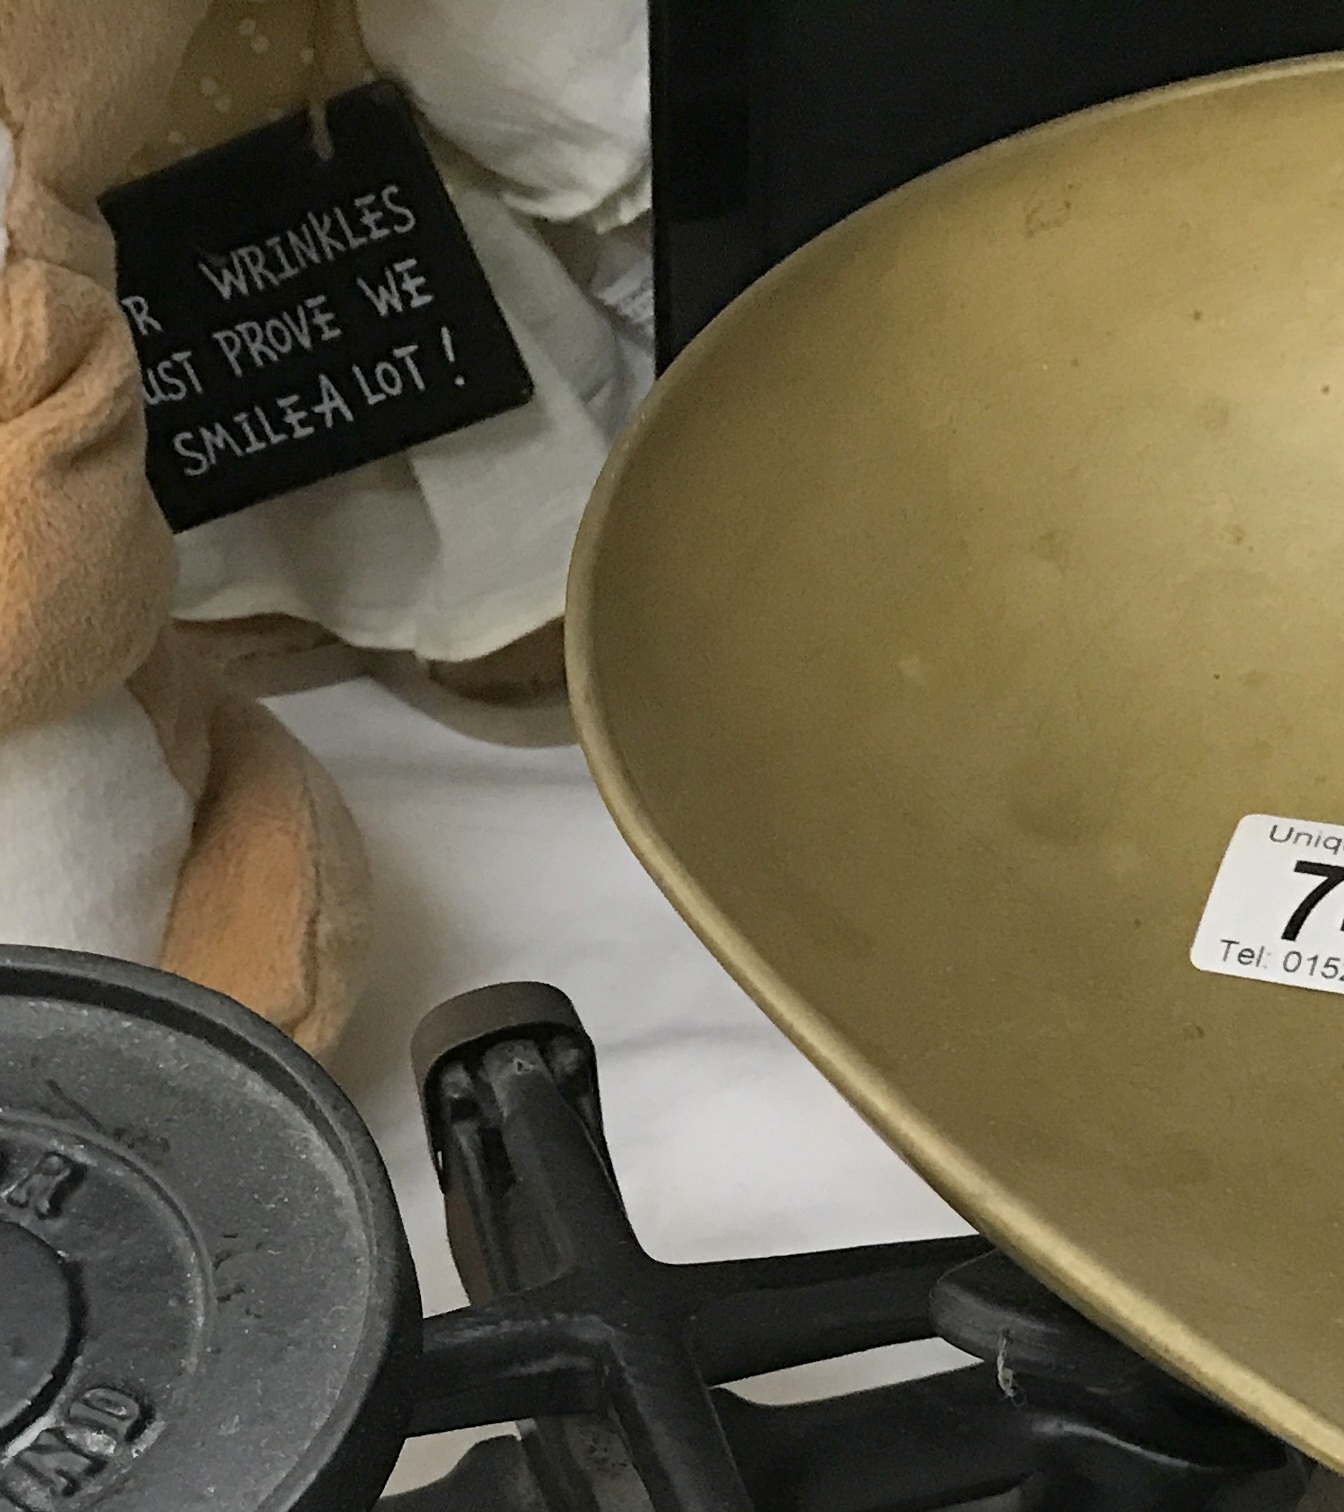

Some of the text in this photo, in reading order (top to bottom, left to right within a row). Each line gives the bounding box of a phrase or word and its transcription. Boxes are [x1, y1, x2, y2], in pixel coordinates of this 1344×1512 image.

[199, 184, 416, 301] WRINKLES
[142, 258, 436, 405] UST PROVE WE
[173, 394, 316, 477] SMILE
[1220, 938, 1272, 969] Tel:
